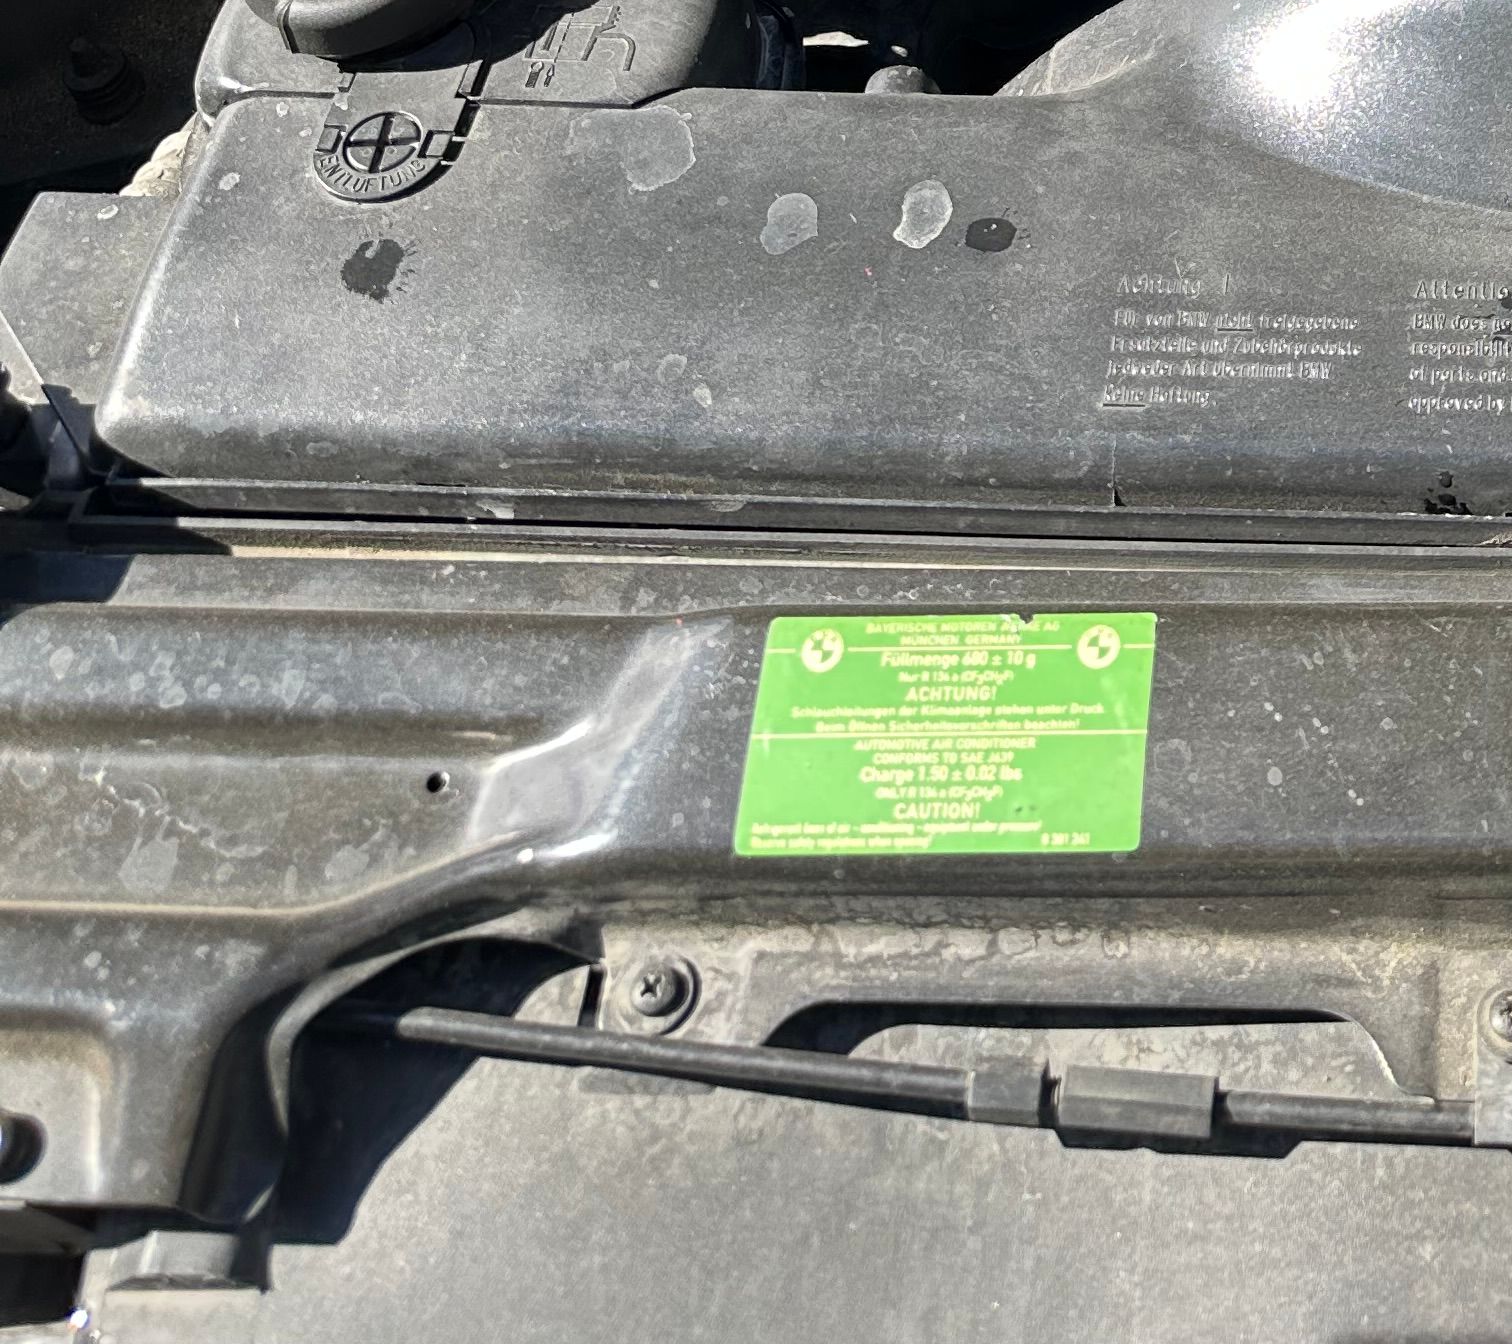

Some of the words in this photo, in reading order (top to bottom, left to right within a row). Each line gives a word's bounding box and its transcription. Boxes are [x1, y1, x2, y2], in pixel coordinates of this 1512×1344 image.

[1413, 313, 1447, 330] BMW
[1451, 314, 1487, 330] does
[940, 621, 997, 632] MOTOREN
[880, 651, 960, 669] Füllmenge
[1006, 650, 1024, 666] 10
[1025, 654, 1037, 669] g
[904, 685, 997, 702] ACHTUNG!
[853, 738, 930, 750] AUTOMOTIVE
[956, 737, 1037, 749] CONDITIONER
[943, 751, 957, 764] TO
[960, 751, 985, 763] SAE
[859, 765, 914, 786] Charge
[999, 764, 1023, 781] lbs
[893, 801, 981, 819] CAUTION!
